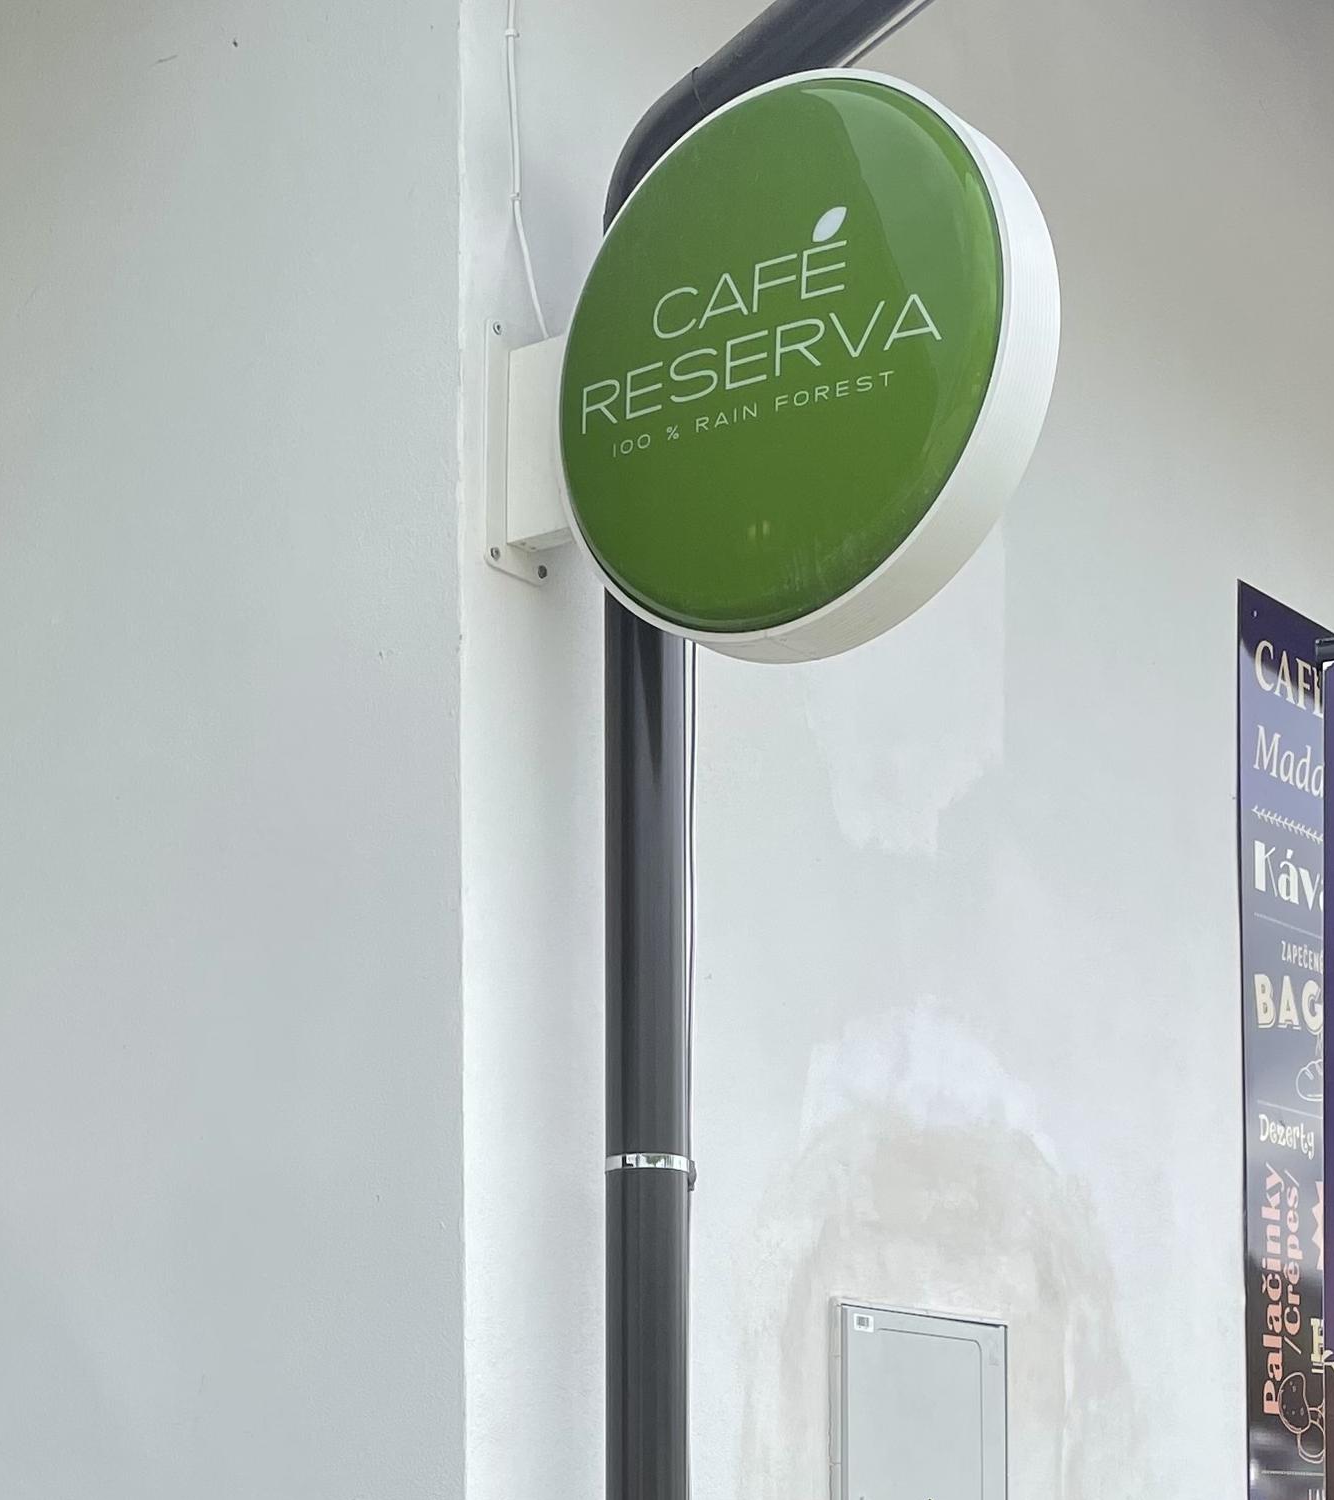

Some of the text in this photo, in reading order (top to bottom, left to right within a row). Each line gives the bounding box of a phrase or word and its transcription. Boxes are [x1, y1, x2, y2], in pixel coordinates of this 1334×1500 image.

[581, 293, 943, 435] RESERVA
[612, 370, 895, 458] 100 % RAIN FOREST
[1253, 724, 1324, 799] Mada
[1253, 973, 1323, 1035] BAG
[1258, 1113, 1315, 1160] Dezerty
[1261, 1161, 1285, 1415] Palačinky
